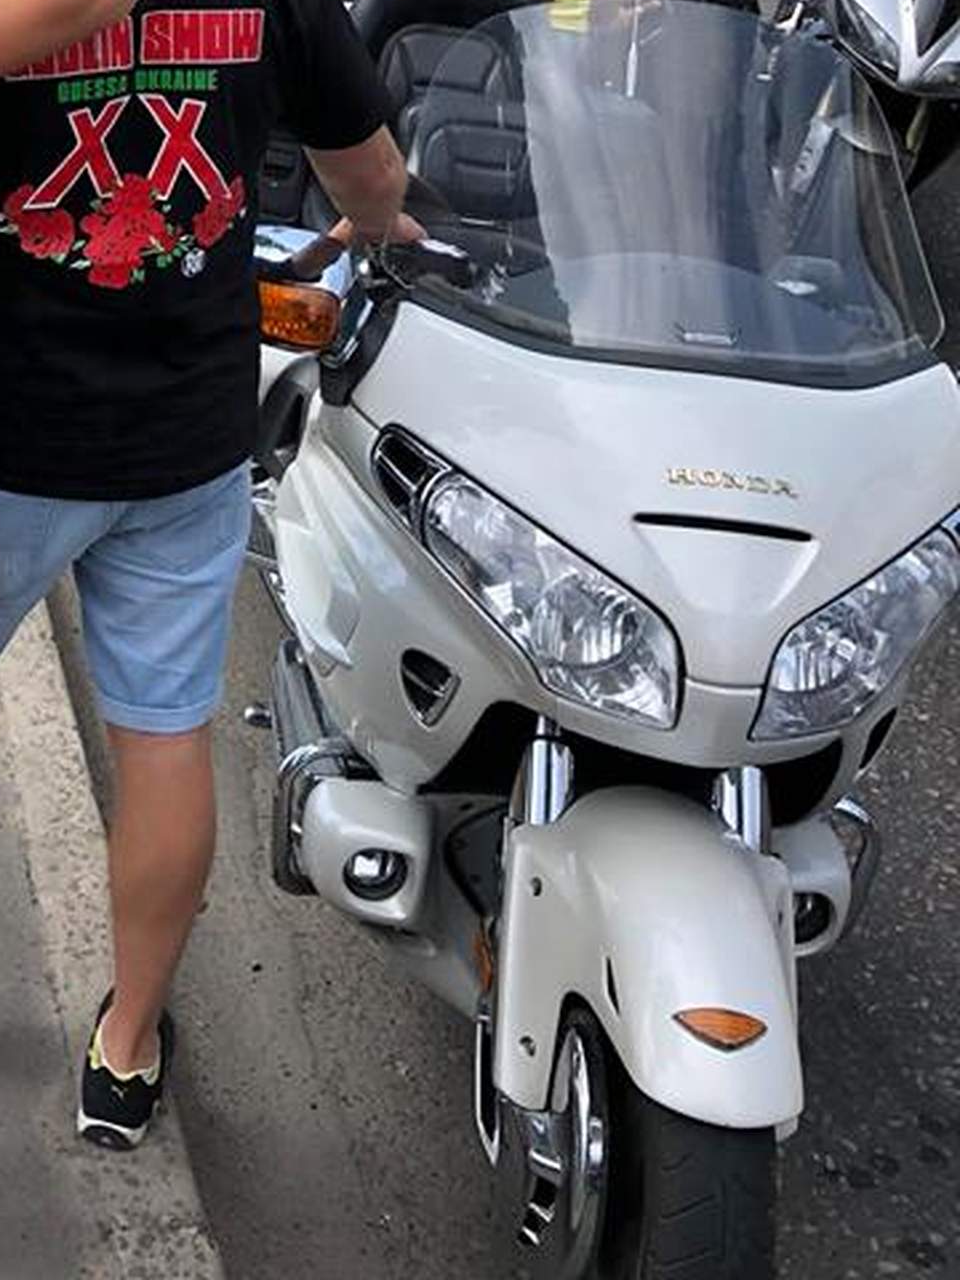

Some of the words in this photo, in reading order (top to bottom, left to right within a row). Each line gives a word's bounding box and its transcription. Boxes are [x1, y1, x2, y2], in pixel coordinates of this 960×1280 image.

[140, 8, 265, 65] SHOW
[134, 69, 218, 91] UKRAINE
[667, 468, 800, 499] HONDA
